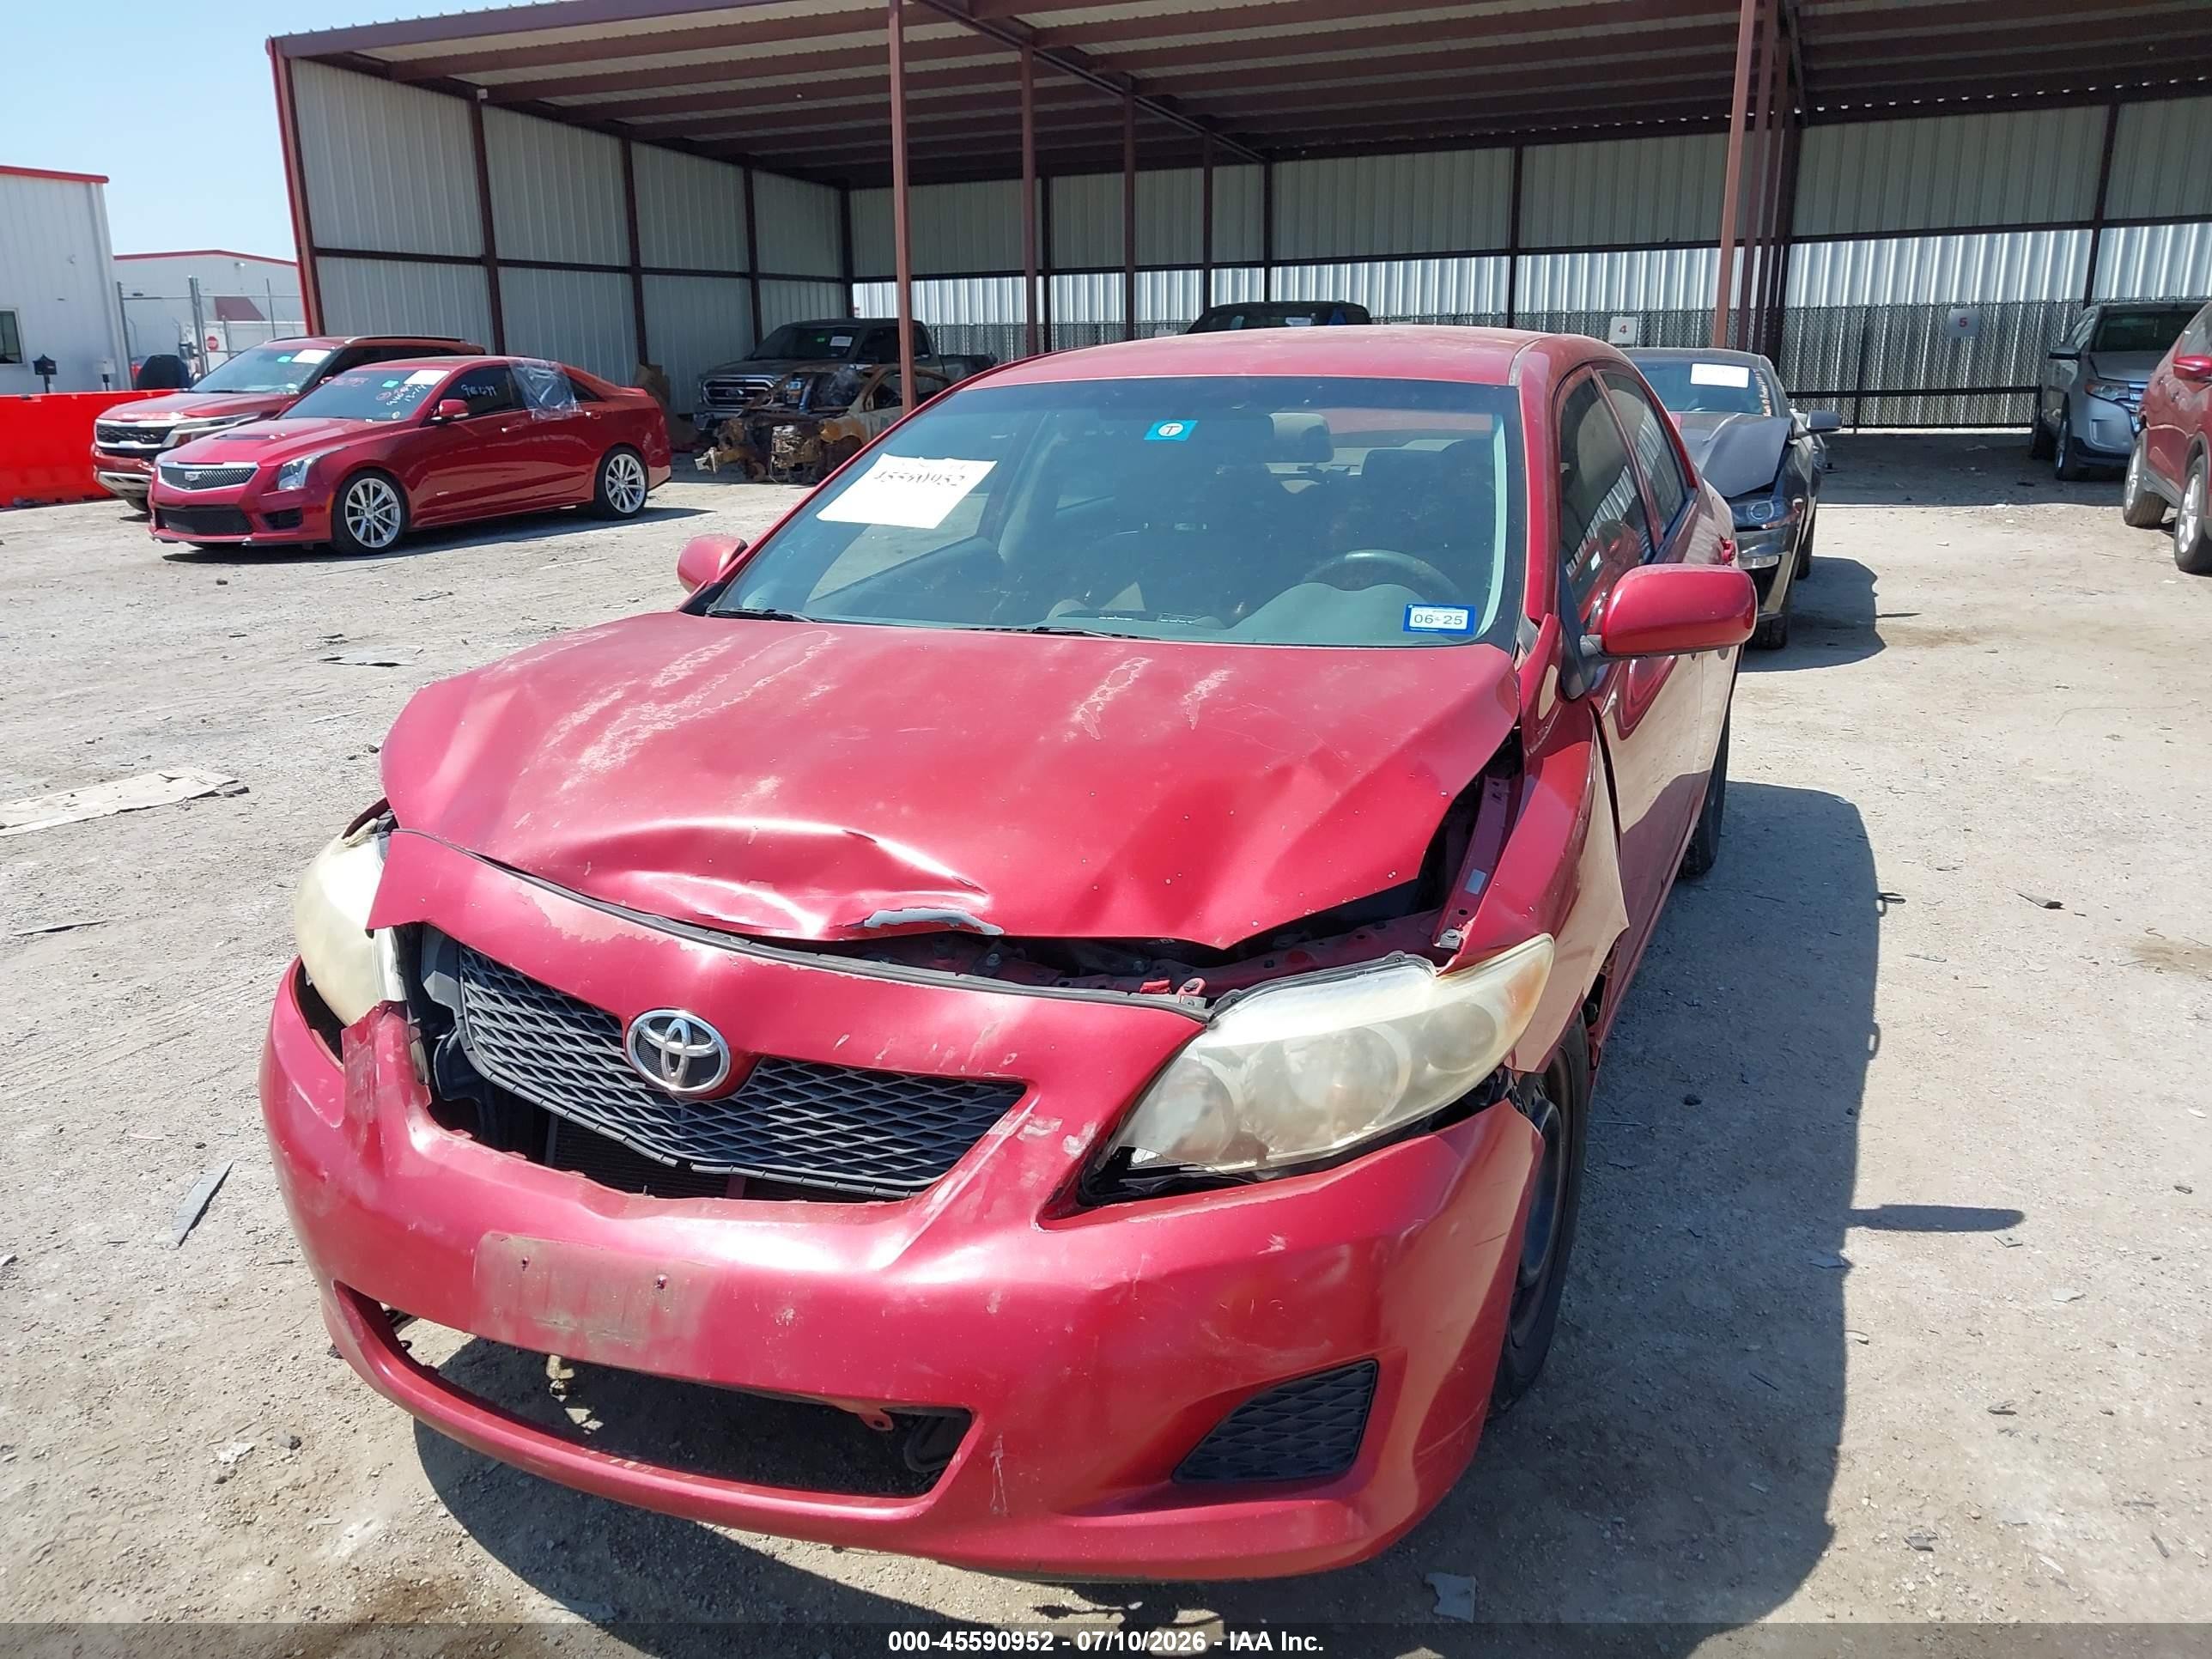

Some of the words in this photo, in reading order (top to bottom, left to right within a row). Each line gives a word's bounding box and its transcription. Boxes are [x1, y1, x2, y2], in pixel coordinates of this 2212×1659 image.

[1959, 317, 1968, 328] 5
[1619, 325, 1627, 335] 4
[1165, 425, 1181, 435] T
